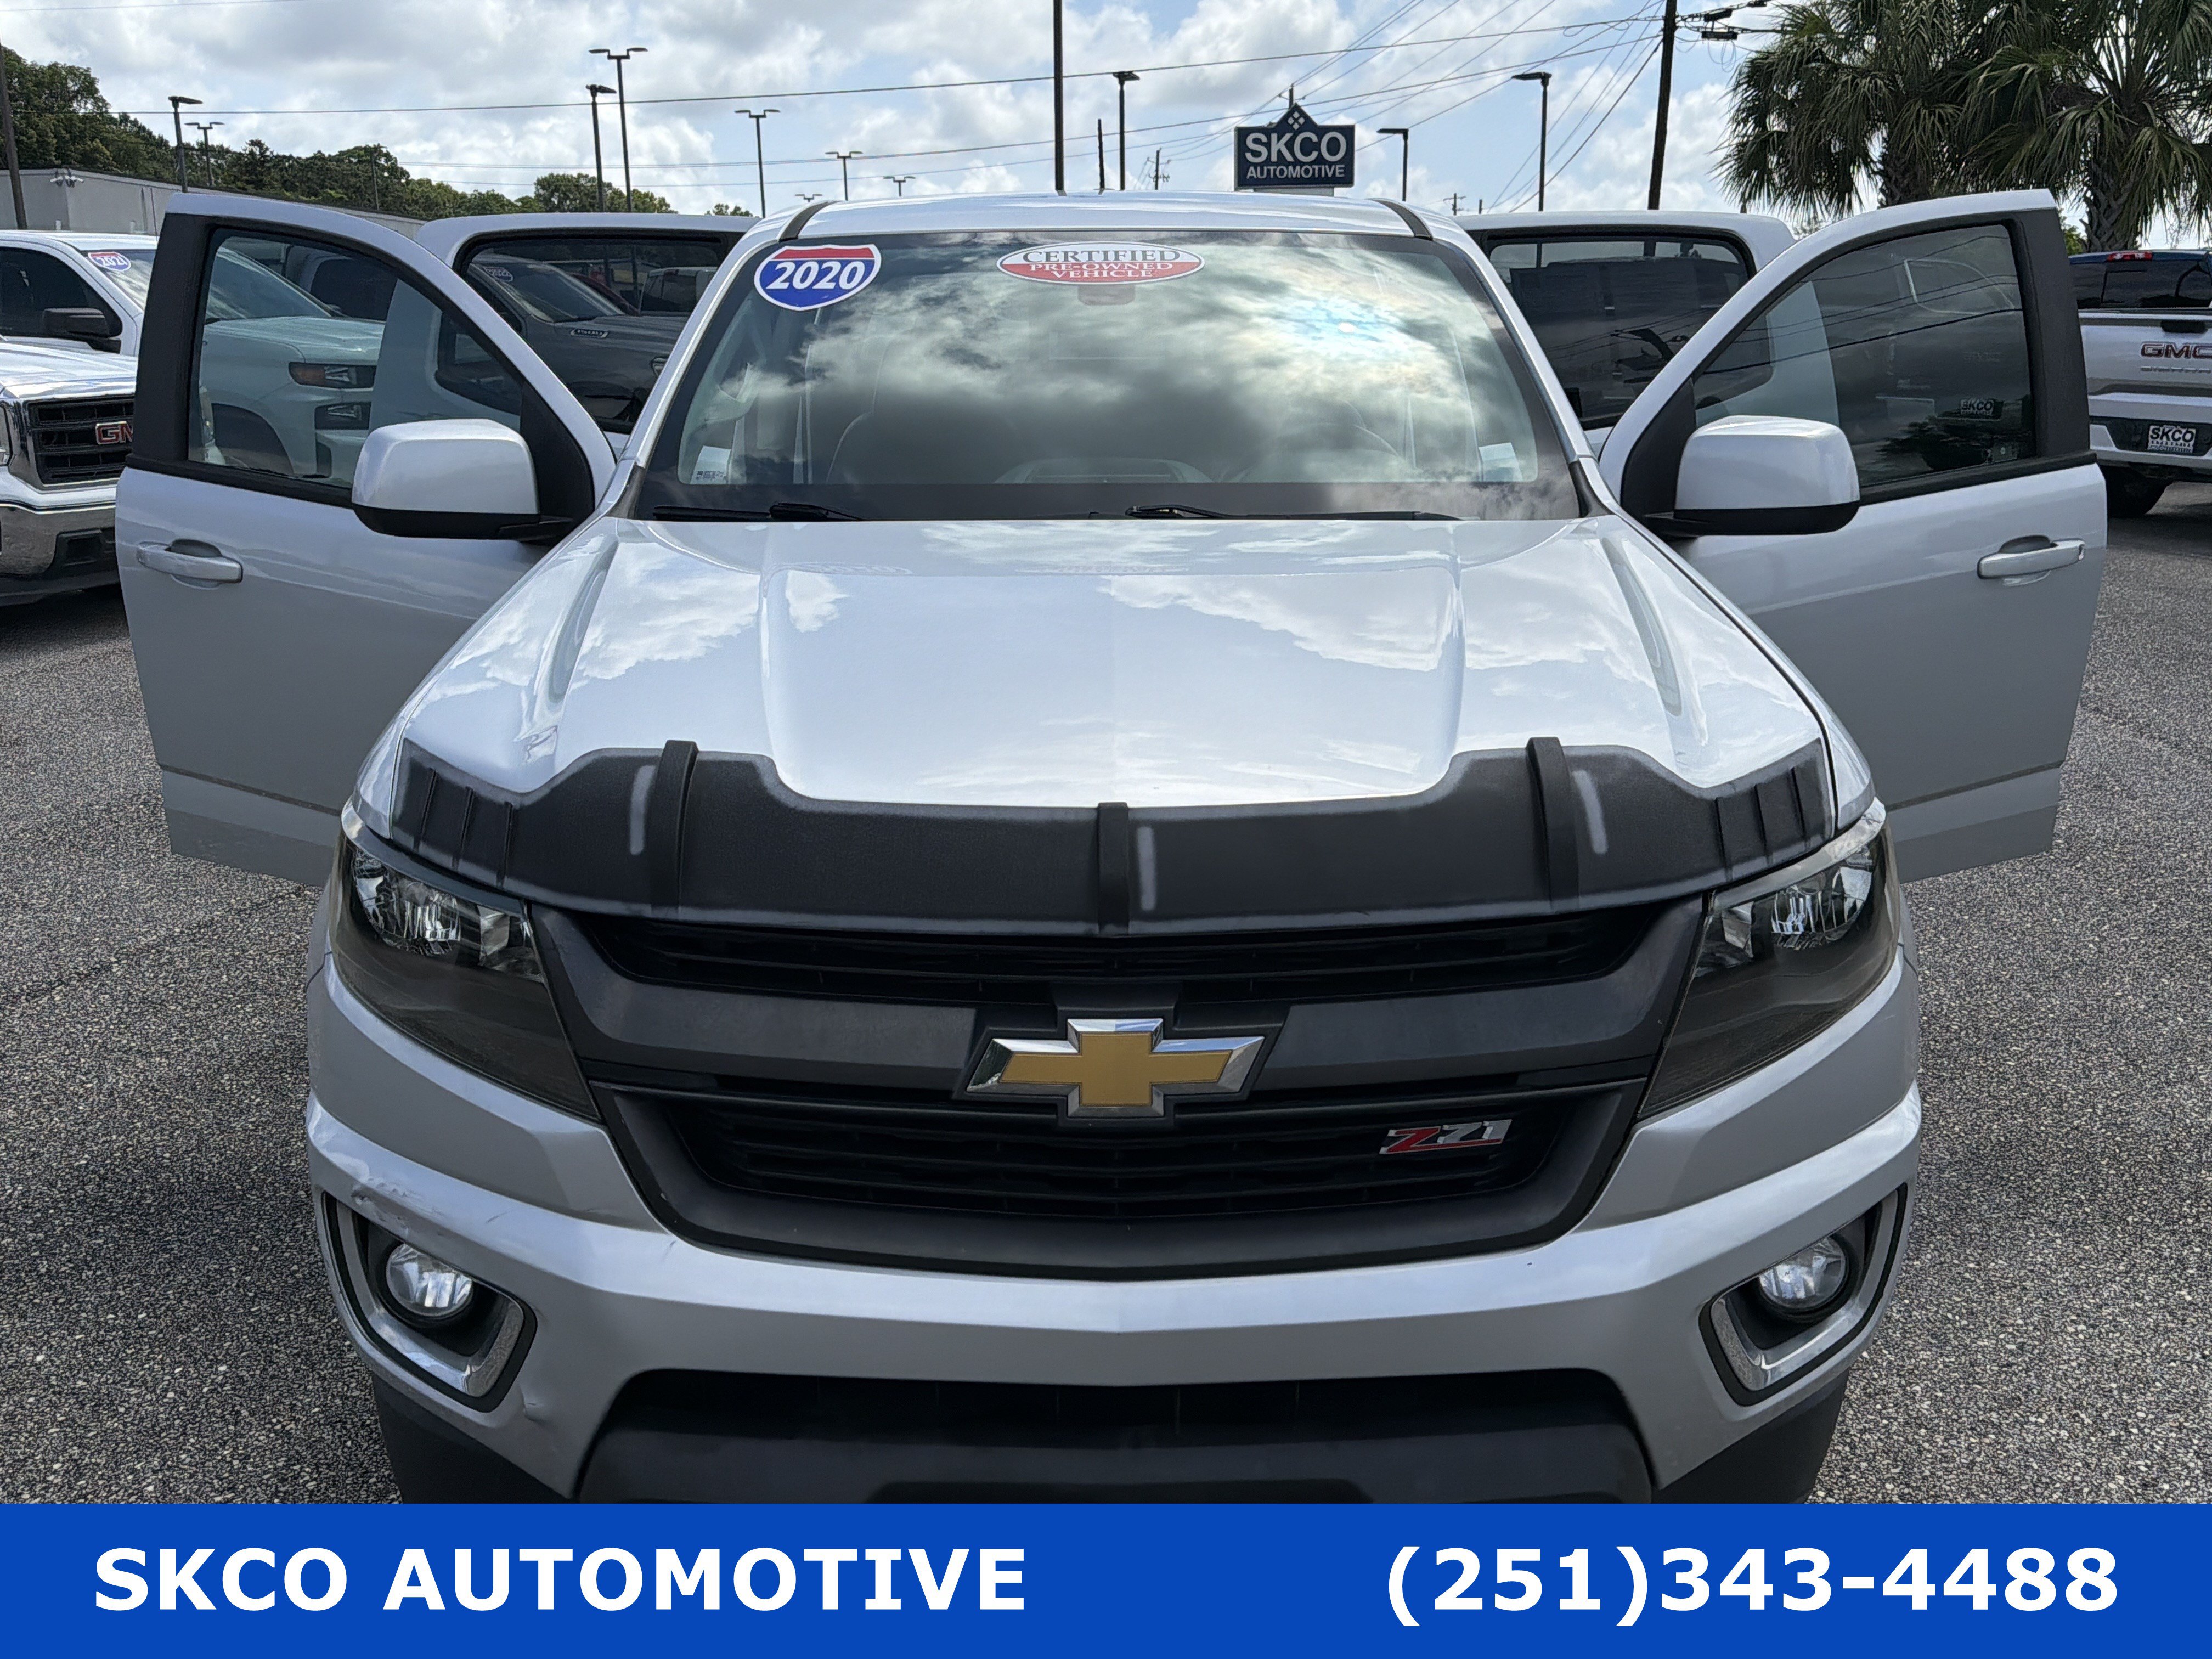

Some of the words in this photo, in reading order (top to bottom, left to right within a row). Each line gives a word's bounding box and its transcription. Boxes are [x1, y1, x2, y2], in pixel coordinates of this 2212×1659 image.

[1245, 132, 1347, 163] SKCO
[1246, 165, 1345, 179] AUTOMOTIVE
[95, 256, 128, 266] 2021
[1022, 249, 1180, 263] CERTIFIED
[1030, 262, 1173, 272] PRE-OWNED
[1051, 270, 1153, 278] VEHICLE
[765, 261, 865, 290] 2020
[2140, 342, 2212, 359] GMC
[2150, 427, 2194, 443] SKCO
[1379, 1119, 1513, 1154] Z71
